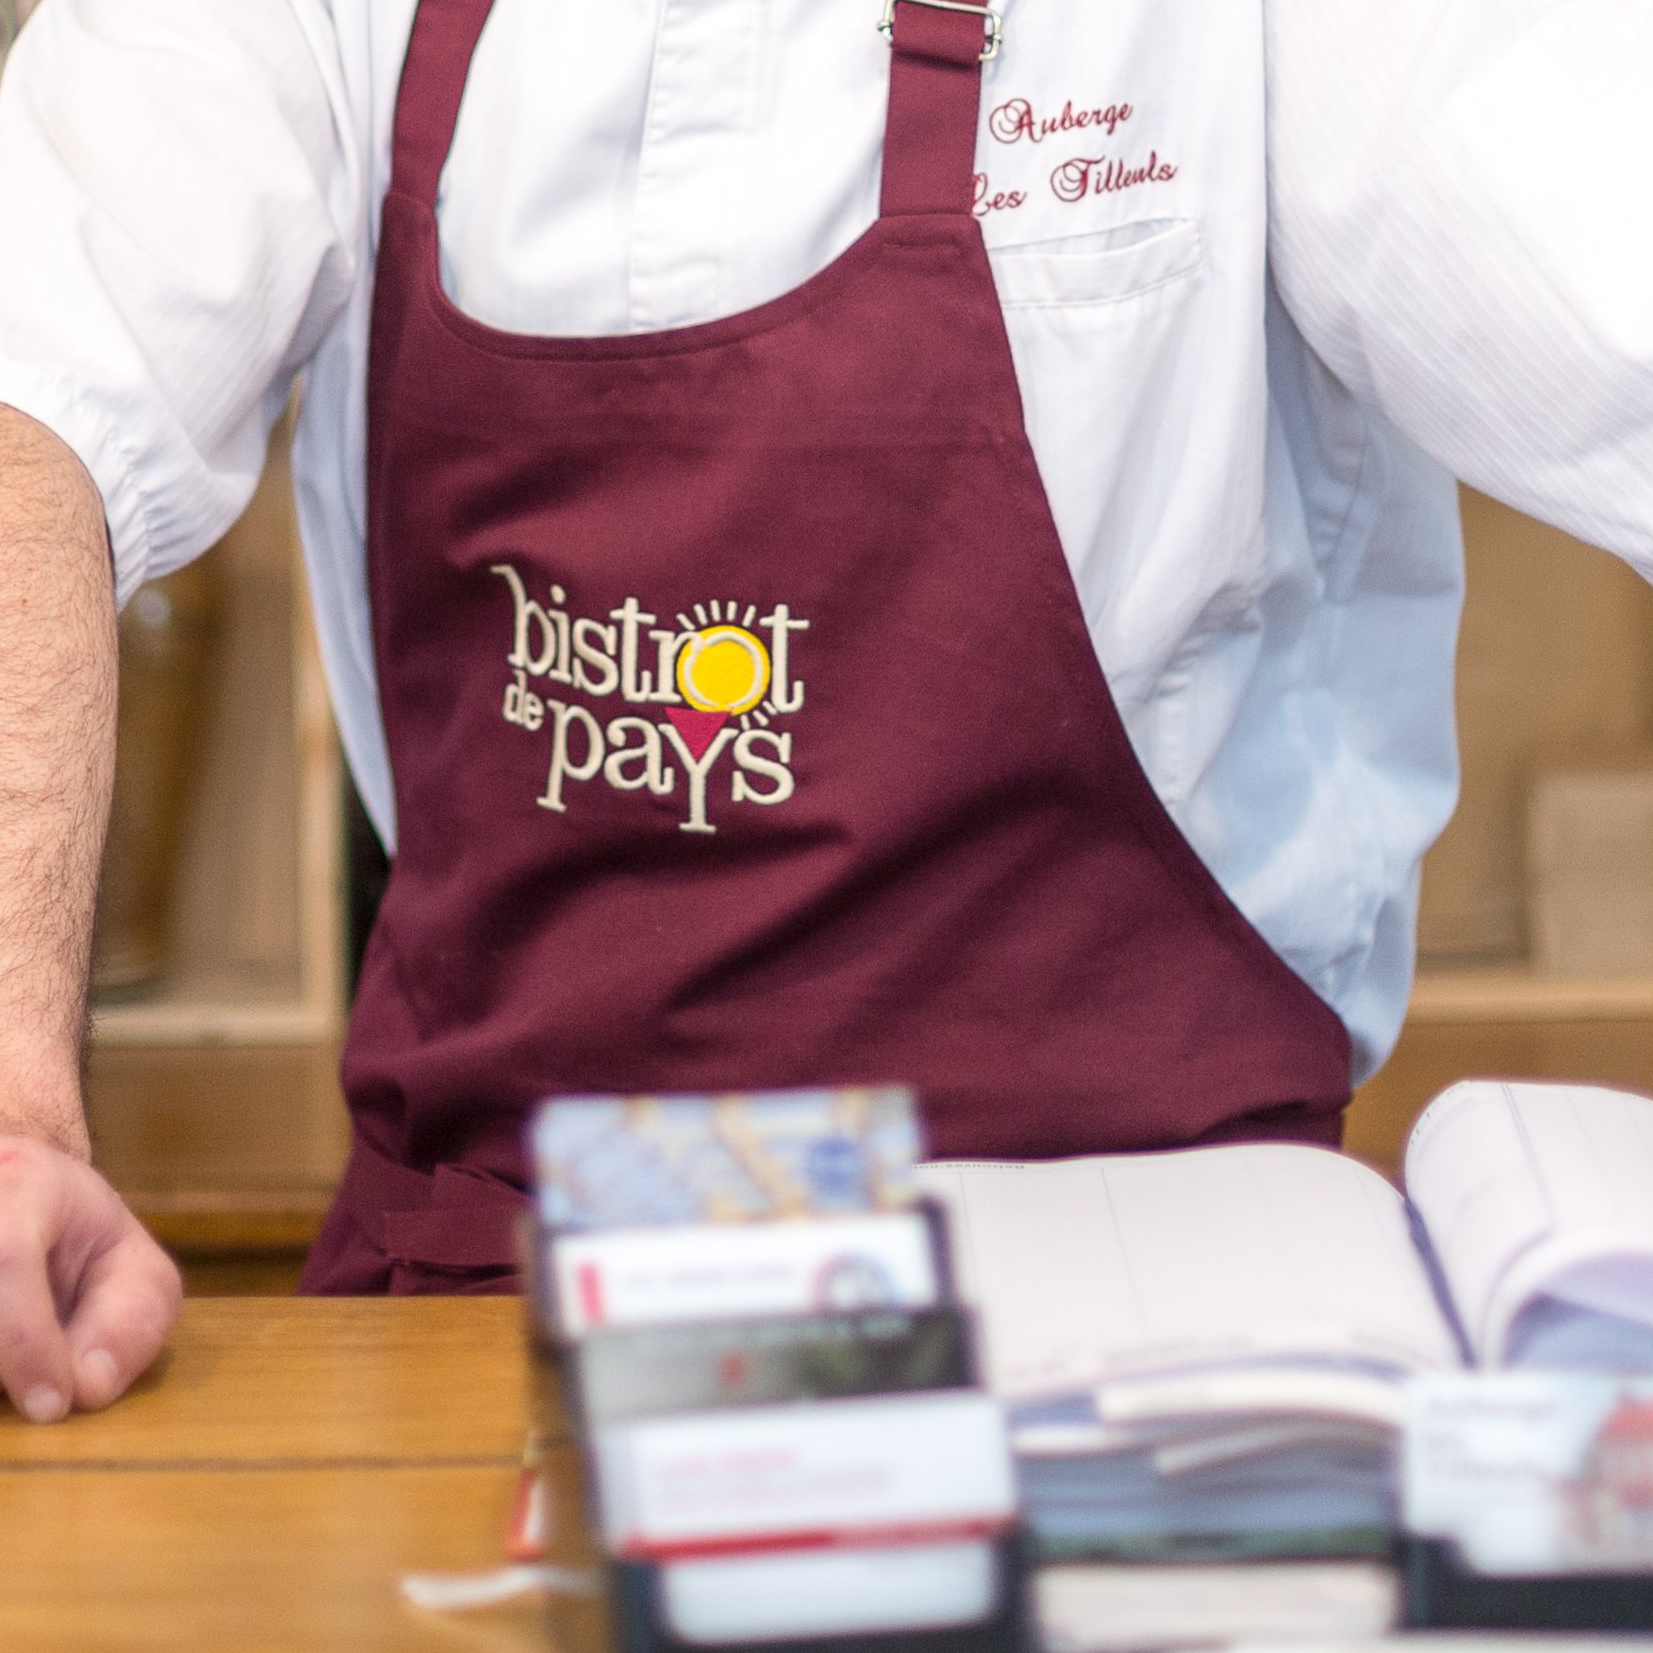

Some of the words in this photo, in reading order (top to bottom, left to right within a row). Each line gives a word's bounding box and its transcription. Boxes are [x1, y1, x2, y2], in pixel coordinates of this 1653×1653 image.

[989, 98, 1133, 144] Auberge
[1050, 150, 1179, 203] Tilleuls
[490, 563, 810, 716] bistrot
[503, 668, 544, 732] de
